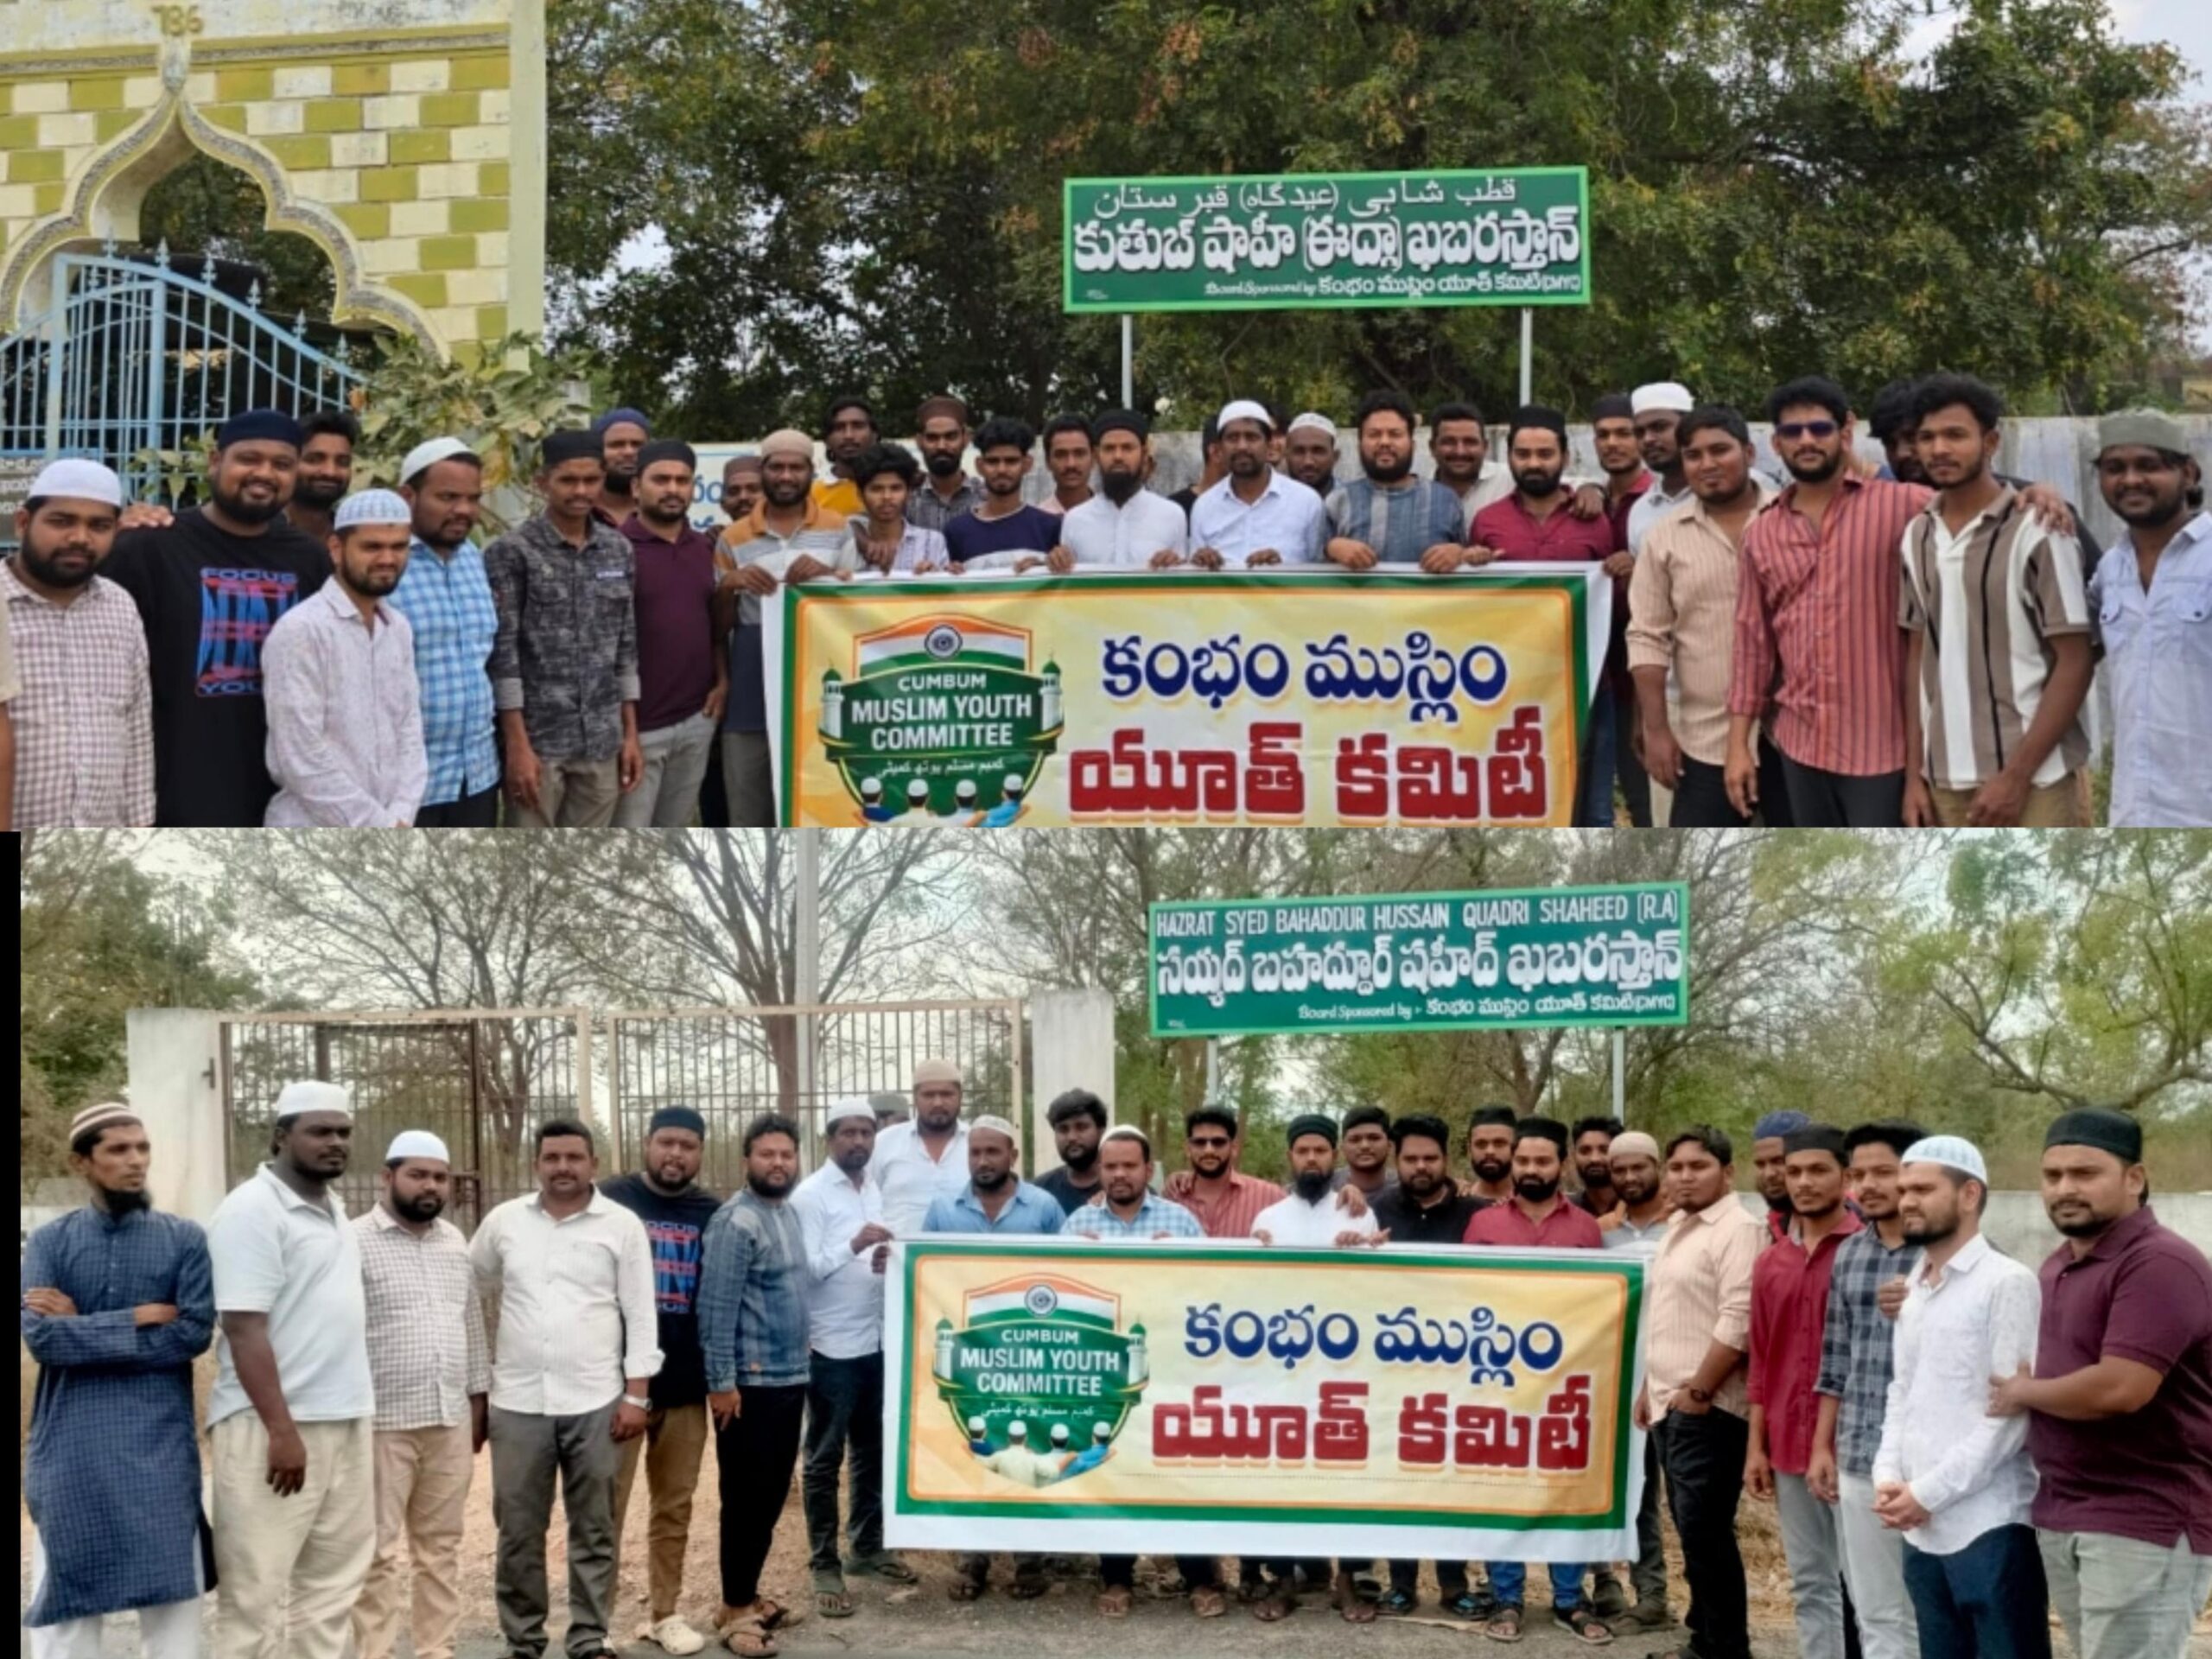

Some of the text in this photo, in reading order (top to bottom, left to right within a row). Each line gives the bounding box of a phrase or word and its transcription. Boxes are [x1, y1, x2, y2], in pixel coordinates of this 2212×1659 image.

[1074, 218, 1196, 271] కుతుబ్
[1202, 214, 1296, 274] షాహీ
[1407, 206, 1580, 271] ఖబరస్తాన్
[899, 674, 987, 691] CUMBUM
[1103, 632, 1508, 724] కంభం ముస్లిం
[852, 695, 1032, 723] MUSLIM YOUTH
[871, 723, 1013, 750] COMMITTEE
[1070, 707, 1549, 820] యూత్ కమిటీ
[1156, 912, 1215, 937] HAZRAT
[1225, 907, 1267, 935] SYED
[1274, 904, 1367, 933] BAHADDUR
[1373, 901, 1449, 930] HUSSAIN
[1463, 898, 1529, 927] QUADRI
[1540, 894, 1628, 923] SHAHEED
[1157, 939, 1245, 1007] సయ్యద్
[1399, 931, 1499, 994] షహీద్
[1507, 930, 1681, 992] ఖబరస్తాన్
[1299, 1004, 1336, 1019] Board
[1338, 1002, 1394, 1020] Sponsored
[1001, 1329, 1079, 1344] CUMBUM
[1184, 1304, 1564, 1386] కంభం ముస్లిం
[960, 1348, 1120, 1371] MUSLIM YOUTH
[976, 1372, 1103, 1396] COMMITTEE
[1152, 1375, 1590, 1471] యూత్ కమిటీ
